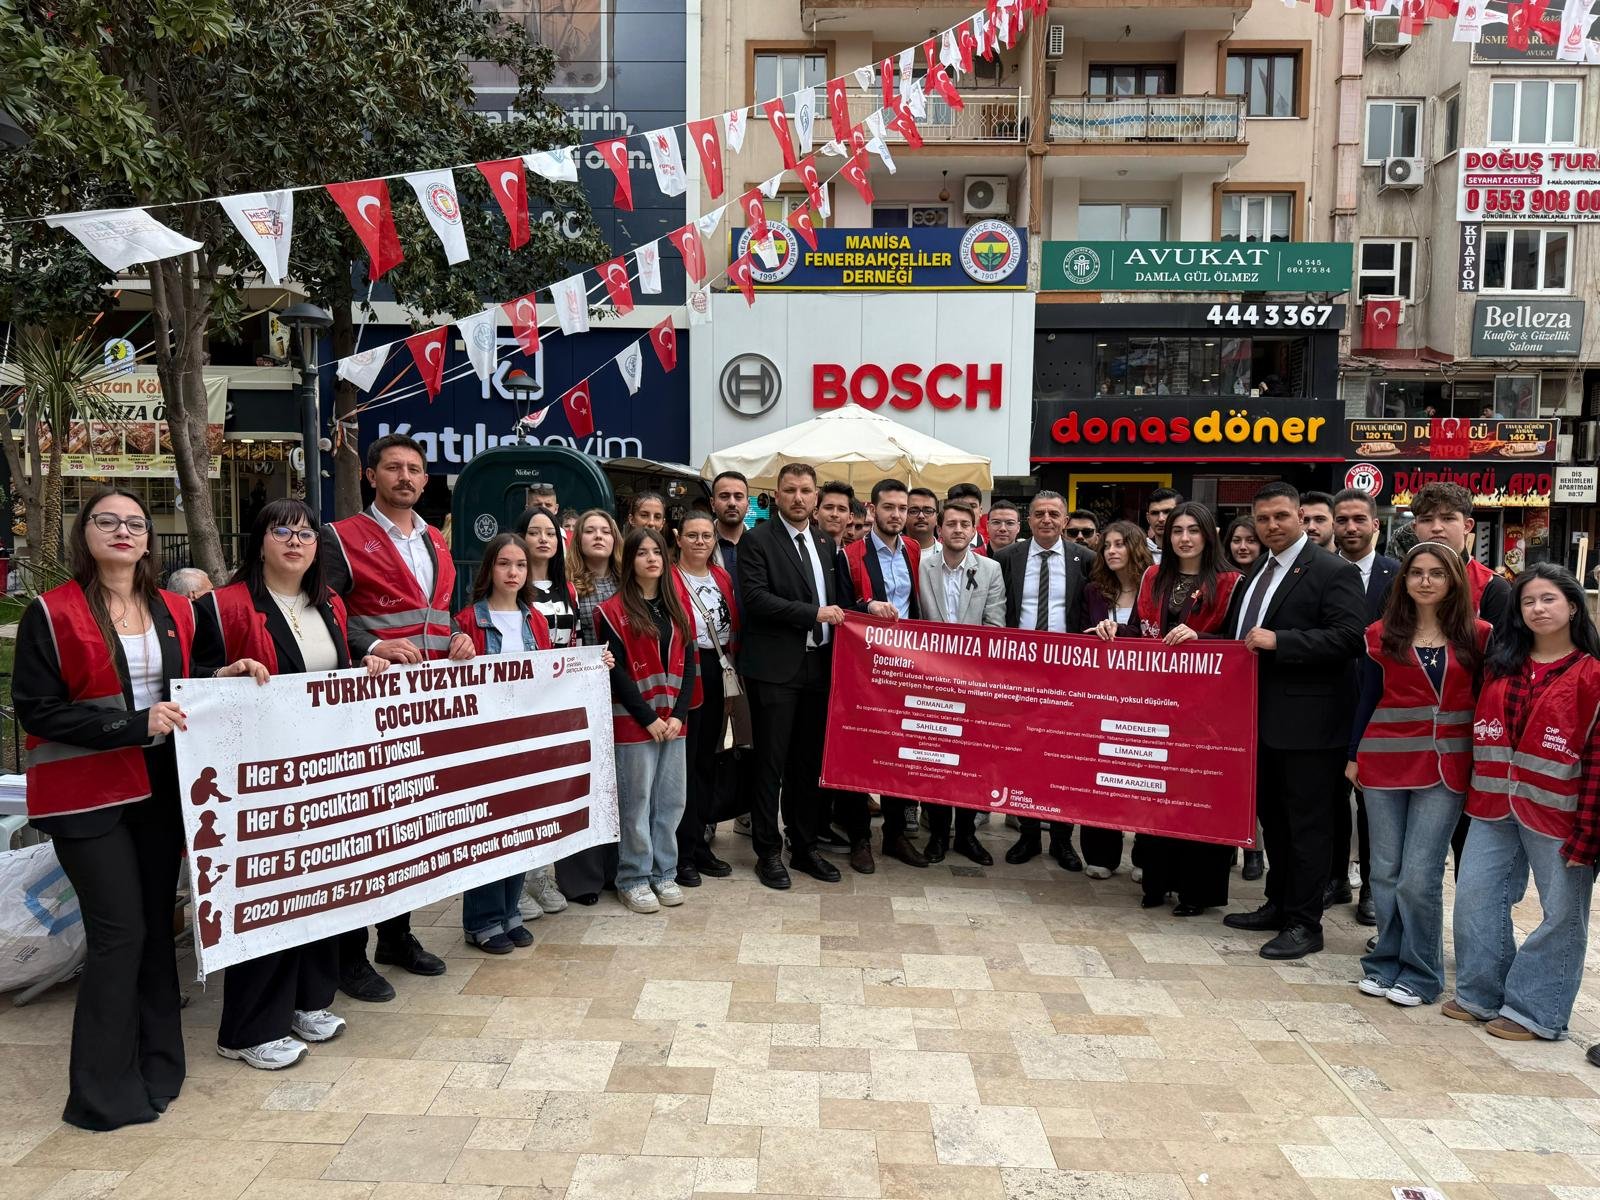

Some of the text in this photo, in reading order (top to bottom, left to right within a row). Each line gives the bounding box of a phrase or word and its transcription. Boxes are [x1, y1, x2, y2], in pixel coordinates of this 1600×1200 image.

[1466, 149, 1543, 172] DOĞUŞ
[1467, 189, 1480, 212] 0
[1485, 189, 1525, 212] 553
[1531, 189, 1571, 212] 908
[846, 232, 911, 250] MANİSA
[962, 223, 990, 270] FENERBAHÇE
[991, 223, 1013, 237] SPOR
[805, 250, 952, 269] FENERBAHÇELİLER
[1125, 248, 1269, 266] AVUKAT
[1463, 225, 1478, 291] KUAFÖR
[843, 267, 913, 285] DERNEĞİ
[1135, 271, 1260, 283] DAMLA GÜL ÖLMEZ
[1484, 306, 1573, 329] Belleza
[1483, 330, 1572, 342] Kuaför & Güzellik
[1508, 342, 1543, 352] Salonu
[813, 363, 1003, 410] BOSCH
[1365, 432, 1394, 440] 120 TL
[1379, 424, 1403, 432] DÜRÜM
[515, 468, 532, 477] Niobe
[1508, 473, 1553, 497] APO
[865, 626, 1224, 675] ÇOCUKLARIMIZA MİRAS ULUSAL VARLIKLARIMIZ
[871, 677, 898, 686] sağlıksız
[898, 680, 922, 690] yetişen
[923, 683, 934, 691] her
[935, 685, 957, 694] çocuk,
[968, 689, 993, 697] milletin
[994, 692, 1038, 703] geleceğinden
[1039, 698, 1075, 707] çalınandır.
[882, 670, 904, 679] değerli
[905, 672, 924, 680] ulusal
[925, 674, 952, 684] varlıktır.
[953, 678, 967, 686] Tüm
[968, 680, 988, 688] ulusal
[989, 682, 1023, 692] varlıkların
[1036, 687, 1067, 697] sahibidir.
[1068, 691, 1086, 699] Cahil
[1087, 692, 1119, 703] bırakılan,
[1120, 695, 1143, 704] yoksul
[1144, 698, 1180, 708] düşürülen,
[916, 700, 954, 710] ORMANLAR
[375, 694, 479, 738] ÇOCUKLAR
[916, 722, 948, 733] SAHİLLER
[1115, 723, 1157, 734] MADENLER
[1546, 726, 1560, 734] CHP
[1115, 746, 1153, 758] LİMANLAR
[246, 737, 425, 788] Her 3 çocuktan 1'i yoksul.
[1100, 776, 1163, 790] TARIM ARAZİLERİ
[246, 774, 440, 833] Her 6 çocuktan 1'i çalışıyor.
[247, 802, 493, 880] Her 5 çocuktan 1'i liseyi bitiremiyor.
[243, 820, 562, 924] 2020 yılında 15-17 yaş arasında 8 bin 154 çocuk doğum yaptı.
